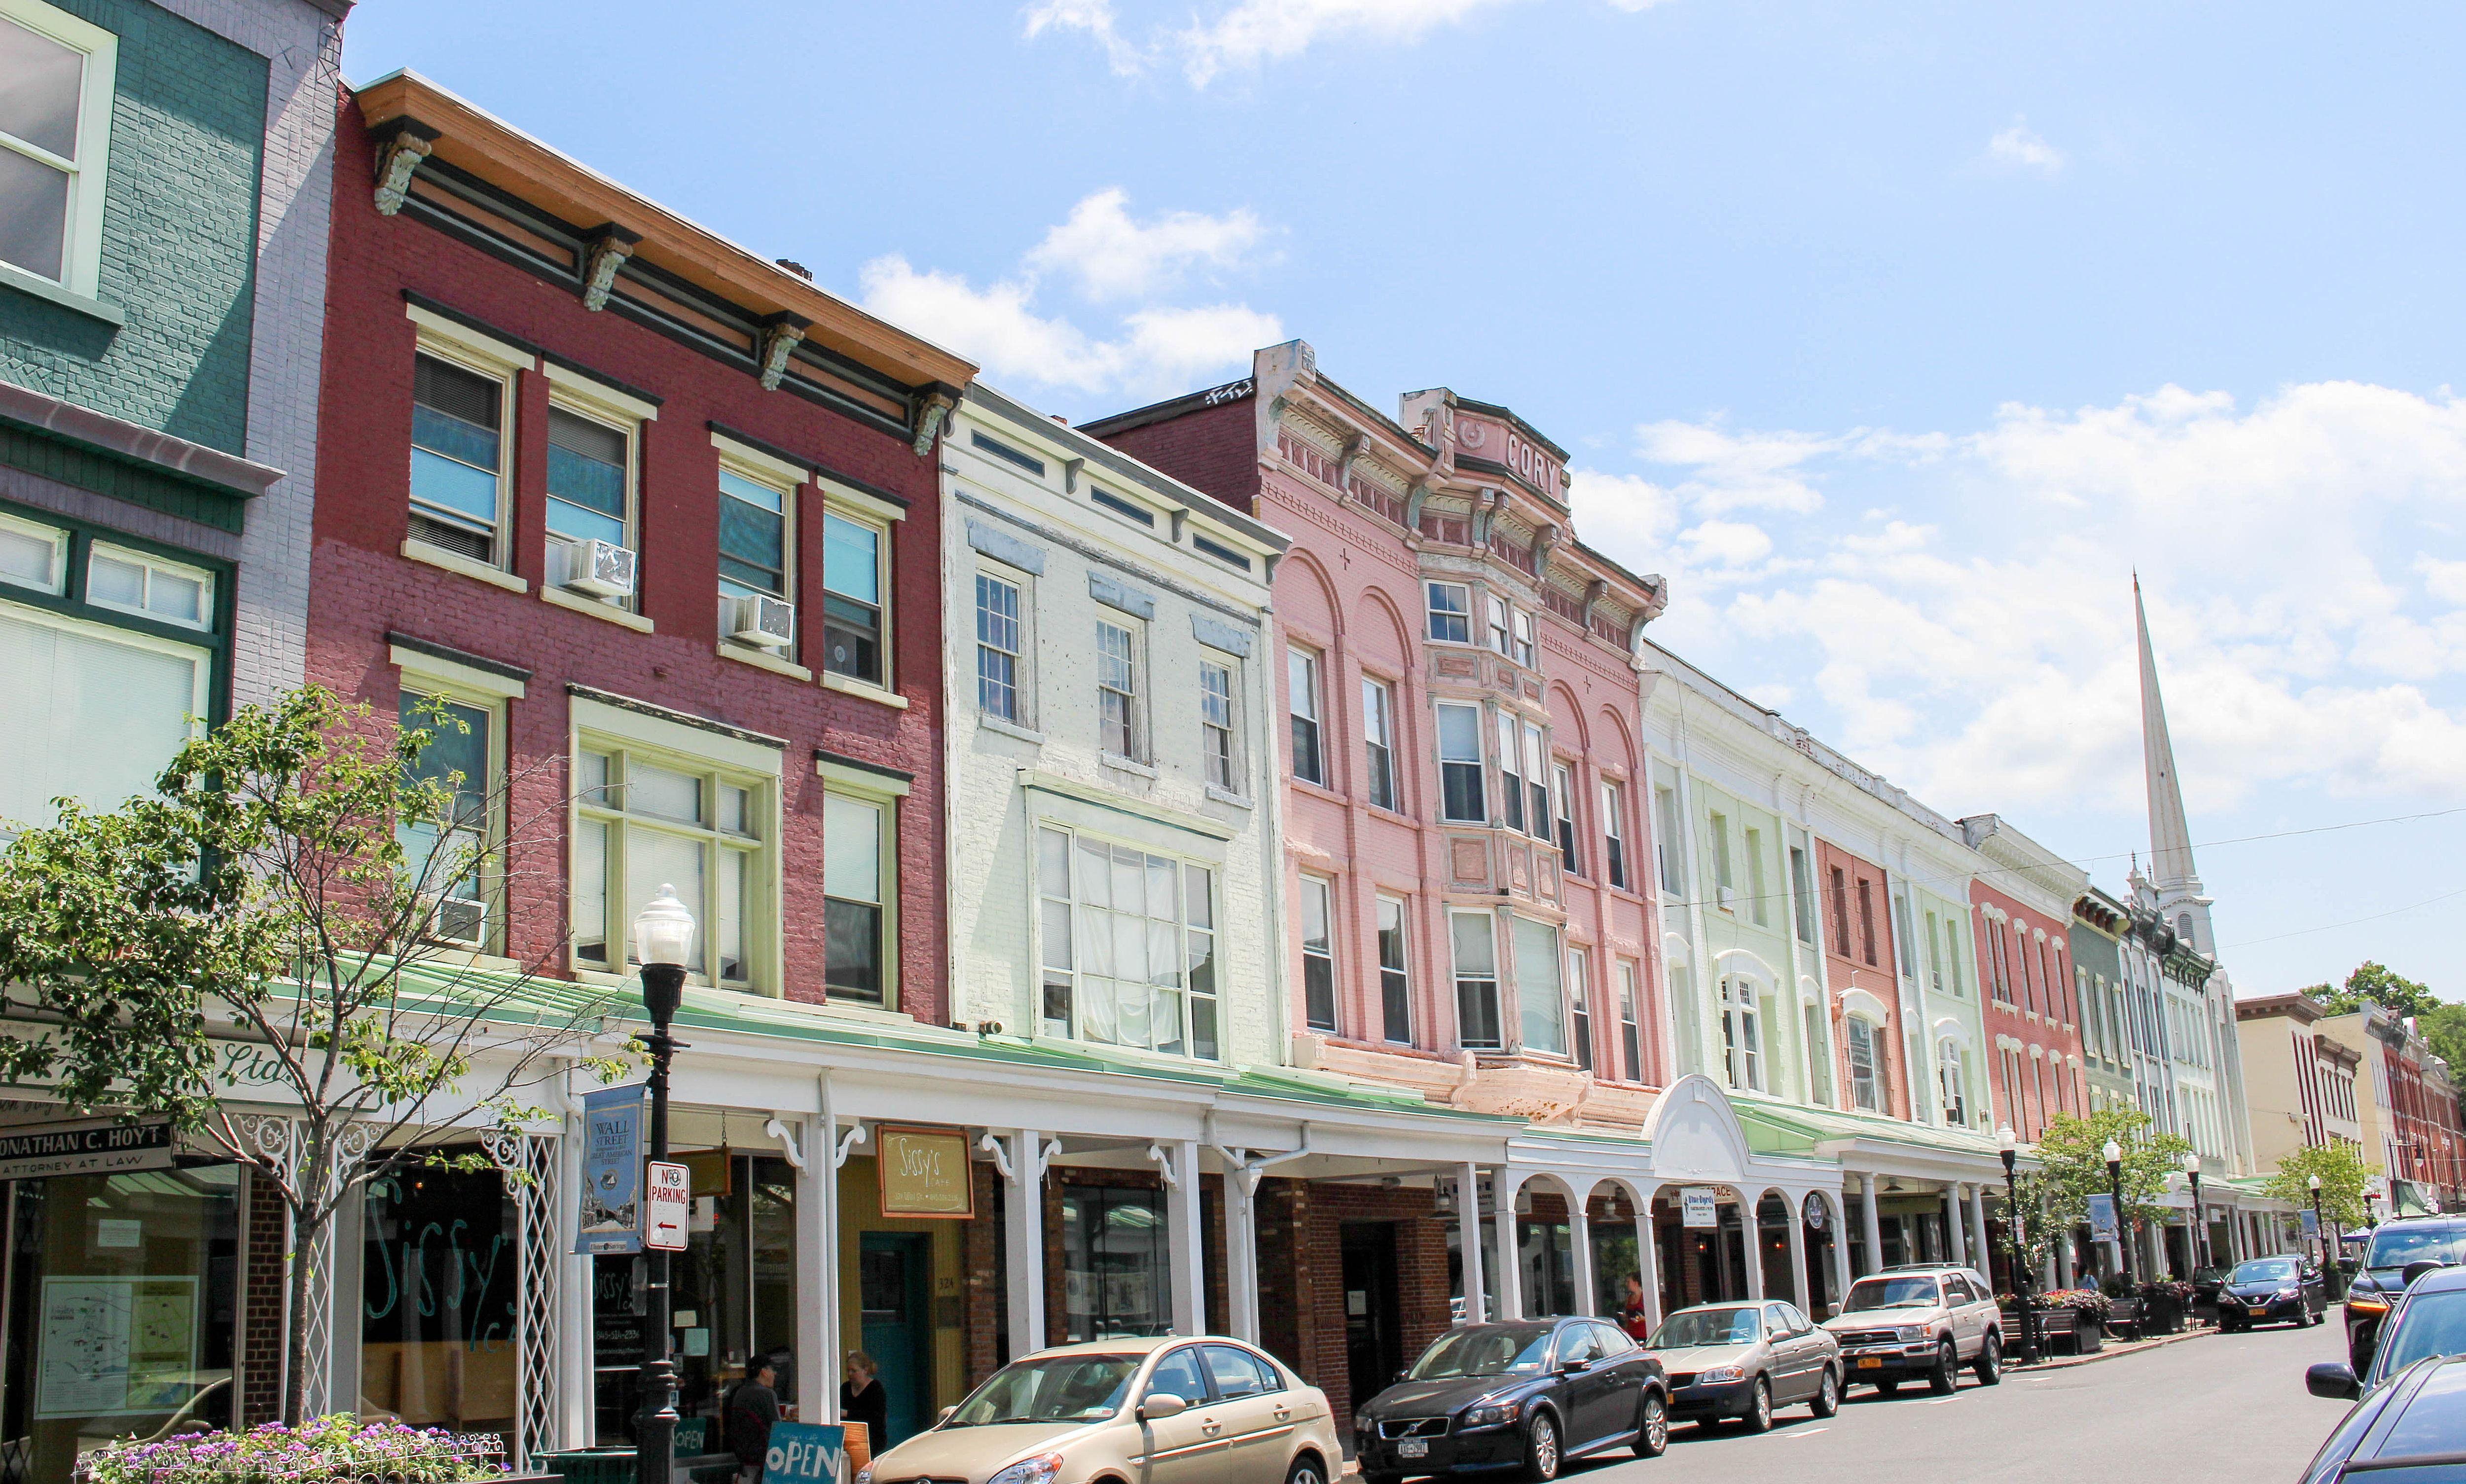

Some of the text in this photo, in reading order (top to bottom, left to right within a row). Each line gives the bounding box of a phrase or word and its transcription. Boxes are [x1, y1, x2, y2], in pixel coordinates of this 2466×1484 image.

[1508, 434, 1556, 493] CORY
[596, 1120, 629, 1134] WALL
[86, 1132, 102, 1150] C.
[109, 1126, 159, 1147] HOYT
[595, 1134, 629, 1146] STREET
[3, 1155, 144, 1174] ATTORNEY AT LAW
[900, 1138, 940, 1187] Sissy's
[662, 1169, 681, 1185] N
[652, 1186, 685, 1204] PARKING
[675, 1431, 704, 1449] OPEN
[765, 1441, 840, 1478] OPEN
